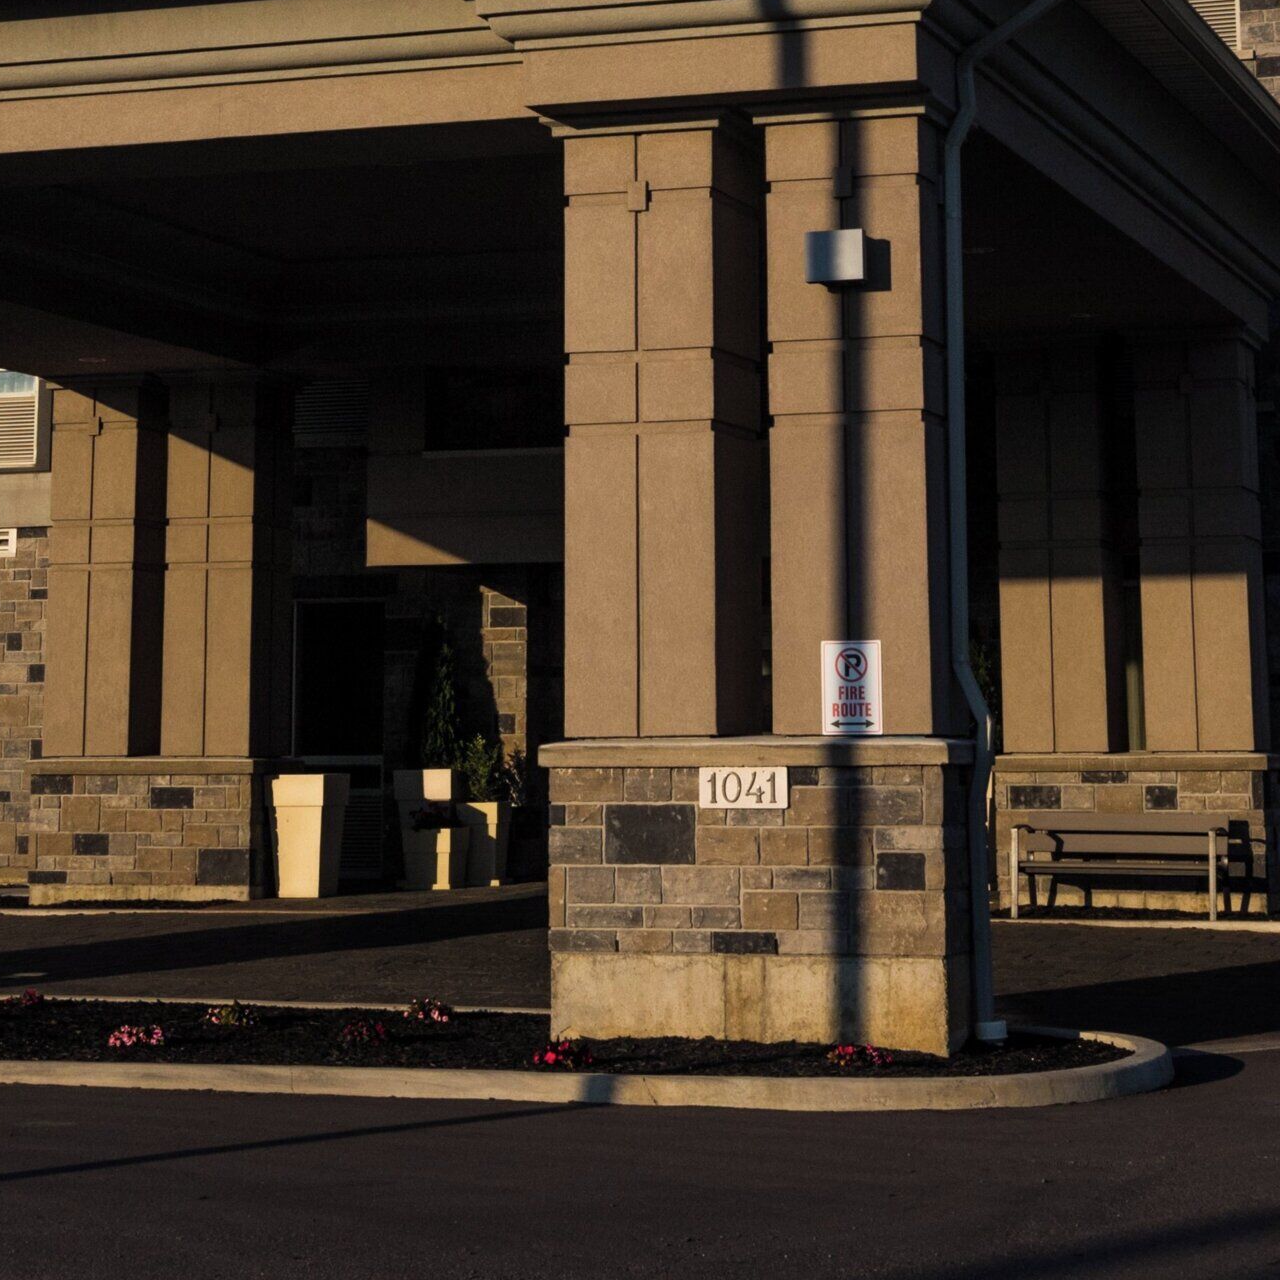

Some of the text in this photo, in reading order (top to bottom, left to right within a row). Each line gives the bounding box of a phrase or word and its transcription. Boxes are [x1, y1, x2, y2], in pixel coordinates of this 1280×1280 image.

[838, 686, 865, 700] FIRE
[832, 702, 872, 718] ROUTE
[707, 771, 777, 804] 1041
